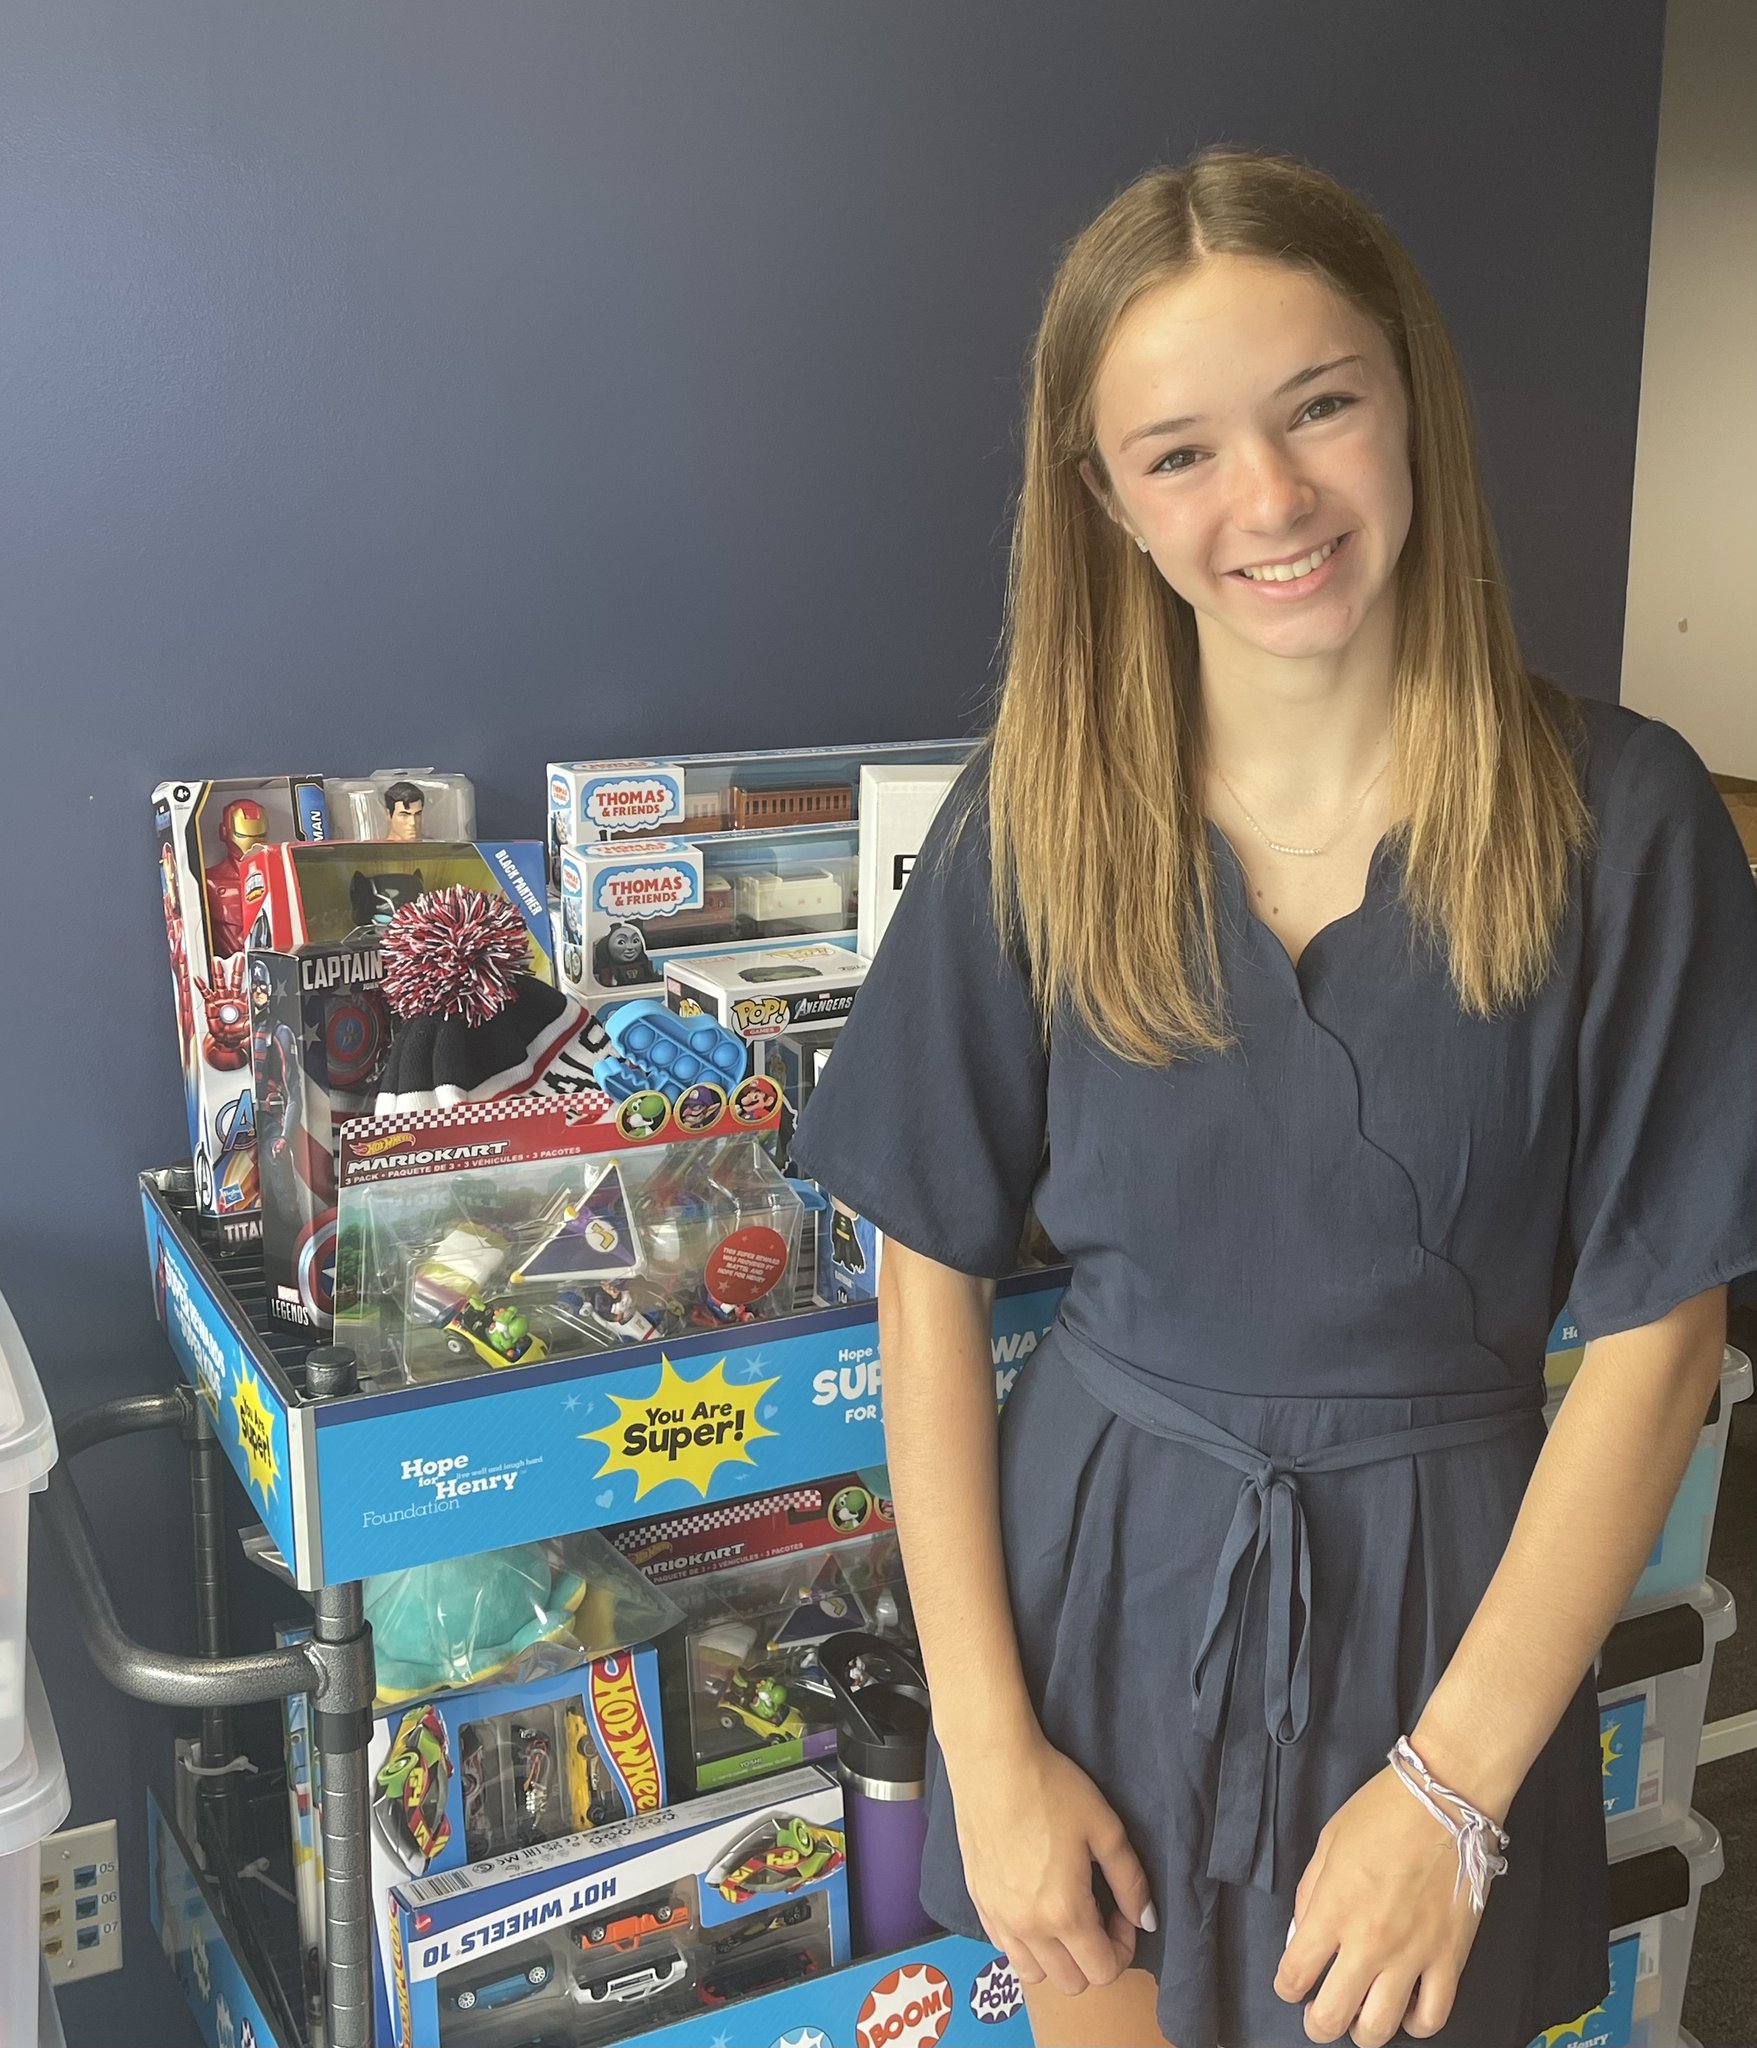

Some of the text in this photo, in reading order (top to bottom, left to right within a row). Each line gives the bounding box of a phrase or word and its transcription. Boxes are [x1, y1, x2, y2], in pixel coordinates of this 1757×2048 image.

[596, 789, 665, 806] THOMAS
[602, 804, 660, 817] & FRIENDS
[495, 849, 543, 917] BLACK PANTHER
[609, 876, 682, 896] THOMAS
[615, 892, 677, 907] & FRIENDS
[302, 951, 383, 990] CAPTAIN
[731, 997, 788, 1030] POP!
[794, 996, 852, 1020] AVENGERS
[345, 1177, 351, 1185] 3
[353, 1172, 379, 1183] PACK
[387, 1165, 432, 1178] PAQUETE
[433, 1163, 447, 1172] DE
[448, 1162, 455, 1171] 3
[464, 1160, 470, 1168] 3
[532, 1151, 539, 1159] 3
[540, 1146, 581, 1158] PACOTES
[347, 1140, 509, 1175] MARIOKART
[224, 1219, 264, 1243] TITA
[271, 1298, 310, 1327] LEGENDS
[838, 1346, 873, 1362] Hope
[812, 1359, 883, 1406] SUP
[645, 1401, 732, 1427] You Are
[845, 1404, 877, 1424] FOR
[622, 1409, 745, 1461] Super!
[401, 1454, 469, 1480] Hope
[418, 1476, 439, 1487] for
[435, 1471, 518, 1500] Henry
[363, 1498, 460, 1529] Foundation
[640, 1542, 745, 1577] ARIOKART
[771, 1542, 804, 1555] PACOTES
[100, 1862, 115, 1873] 05
[101, 1891, 117, 1904] 06
[568, 1876, 618, 1913] HOT
[103, 1921, 119, 1934] 07
[460, 1898, 563, 1954] WHEELS
[423, 1940, 451, 1969] 10
[990, 1972, 1019, 1991] KA-
[979, 1986, 1019, 2009] POW
[868, 1990, 943, 2047] BOOM
